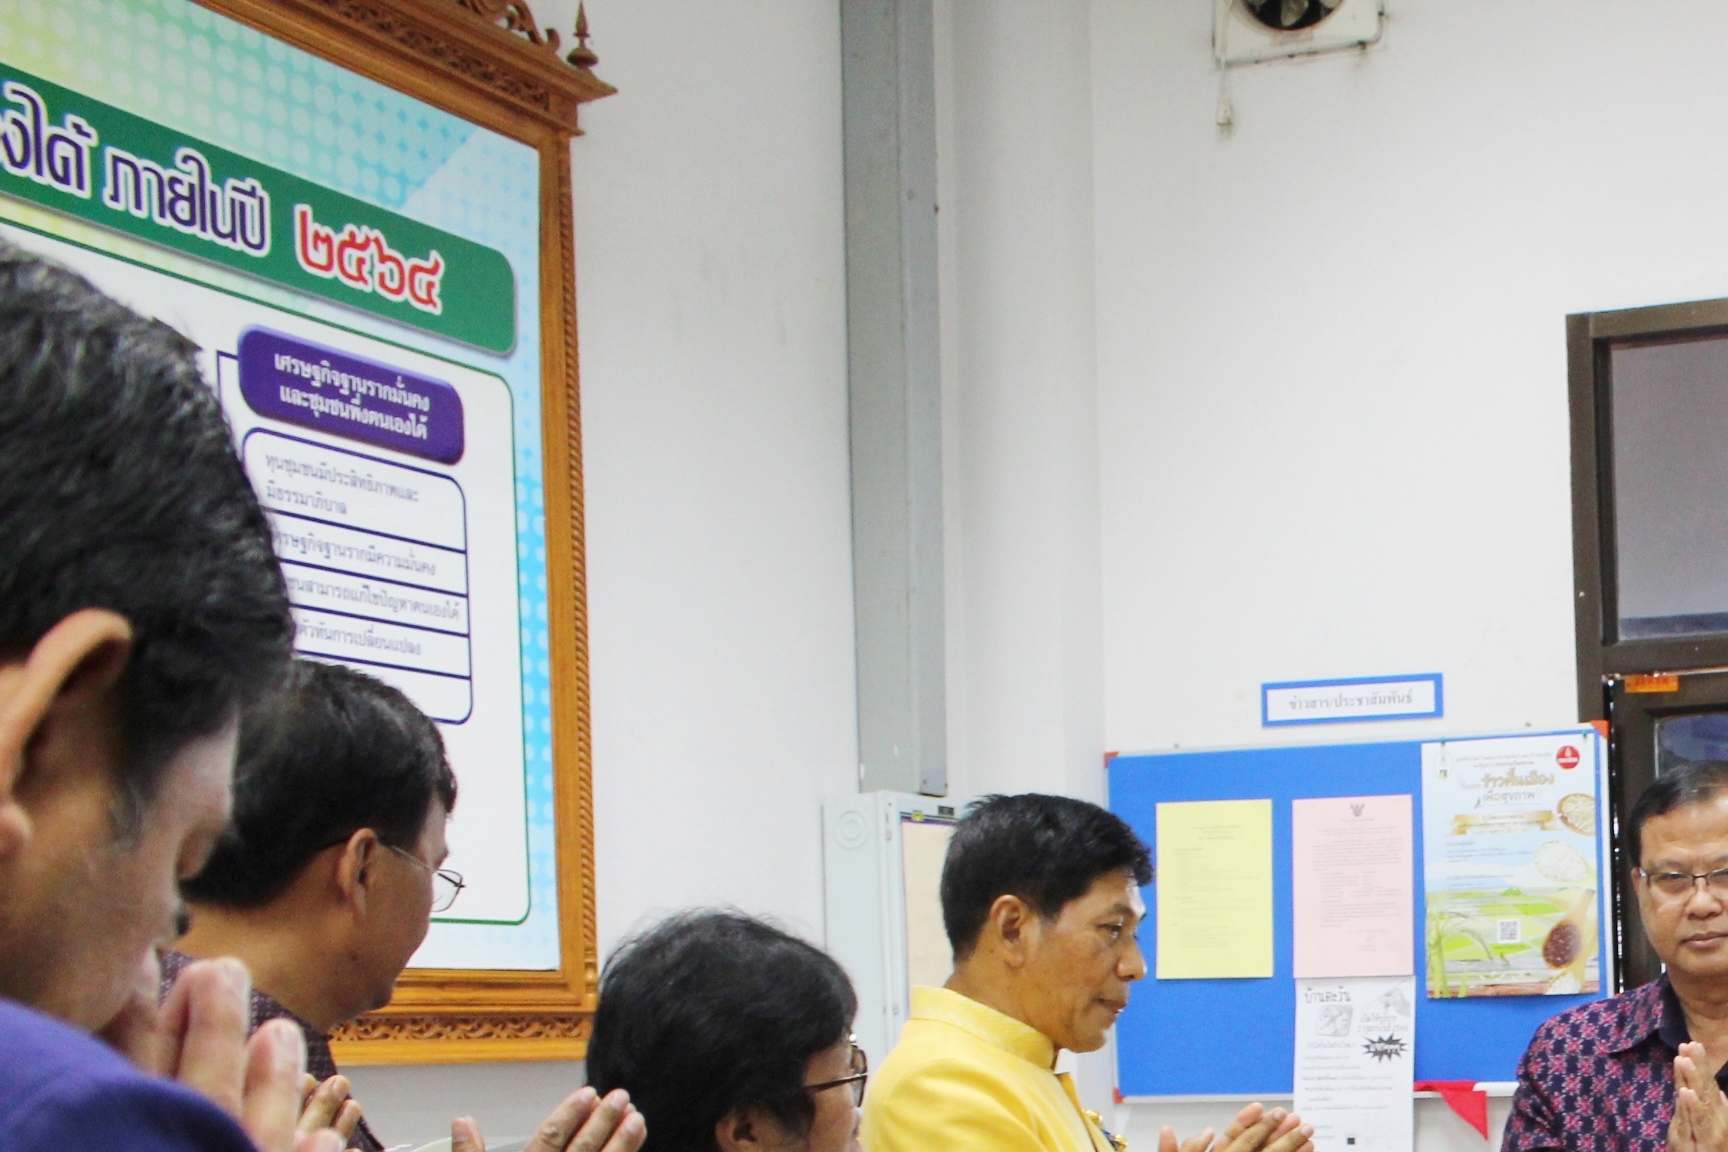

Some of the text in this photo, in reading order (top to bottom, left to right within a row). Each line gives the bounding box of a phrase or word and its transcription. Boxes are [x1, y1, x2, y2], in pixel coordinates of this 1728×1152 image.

[104, 146, 270, 255] ภายในปี
[294, 203, 443, 314] ๒๕๖๔
[274, 353, 431, 412] เศรษฐกิจฐานรากมั่นคง
[279, 385, 429, 440] และชุมชนพึ่งตนเองได้
